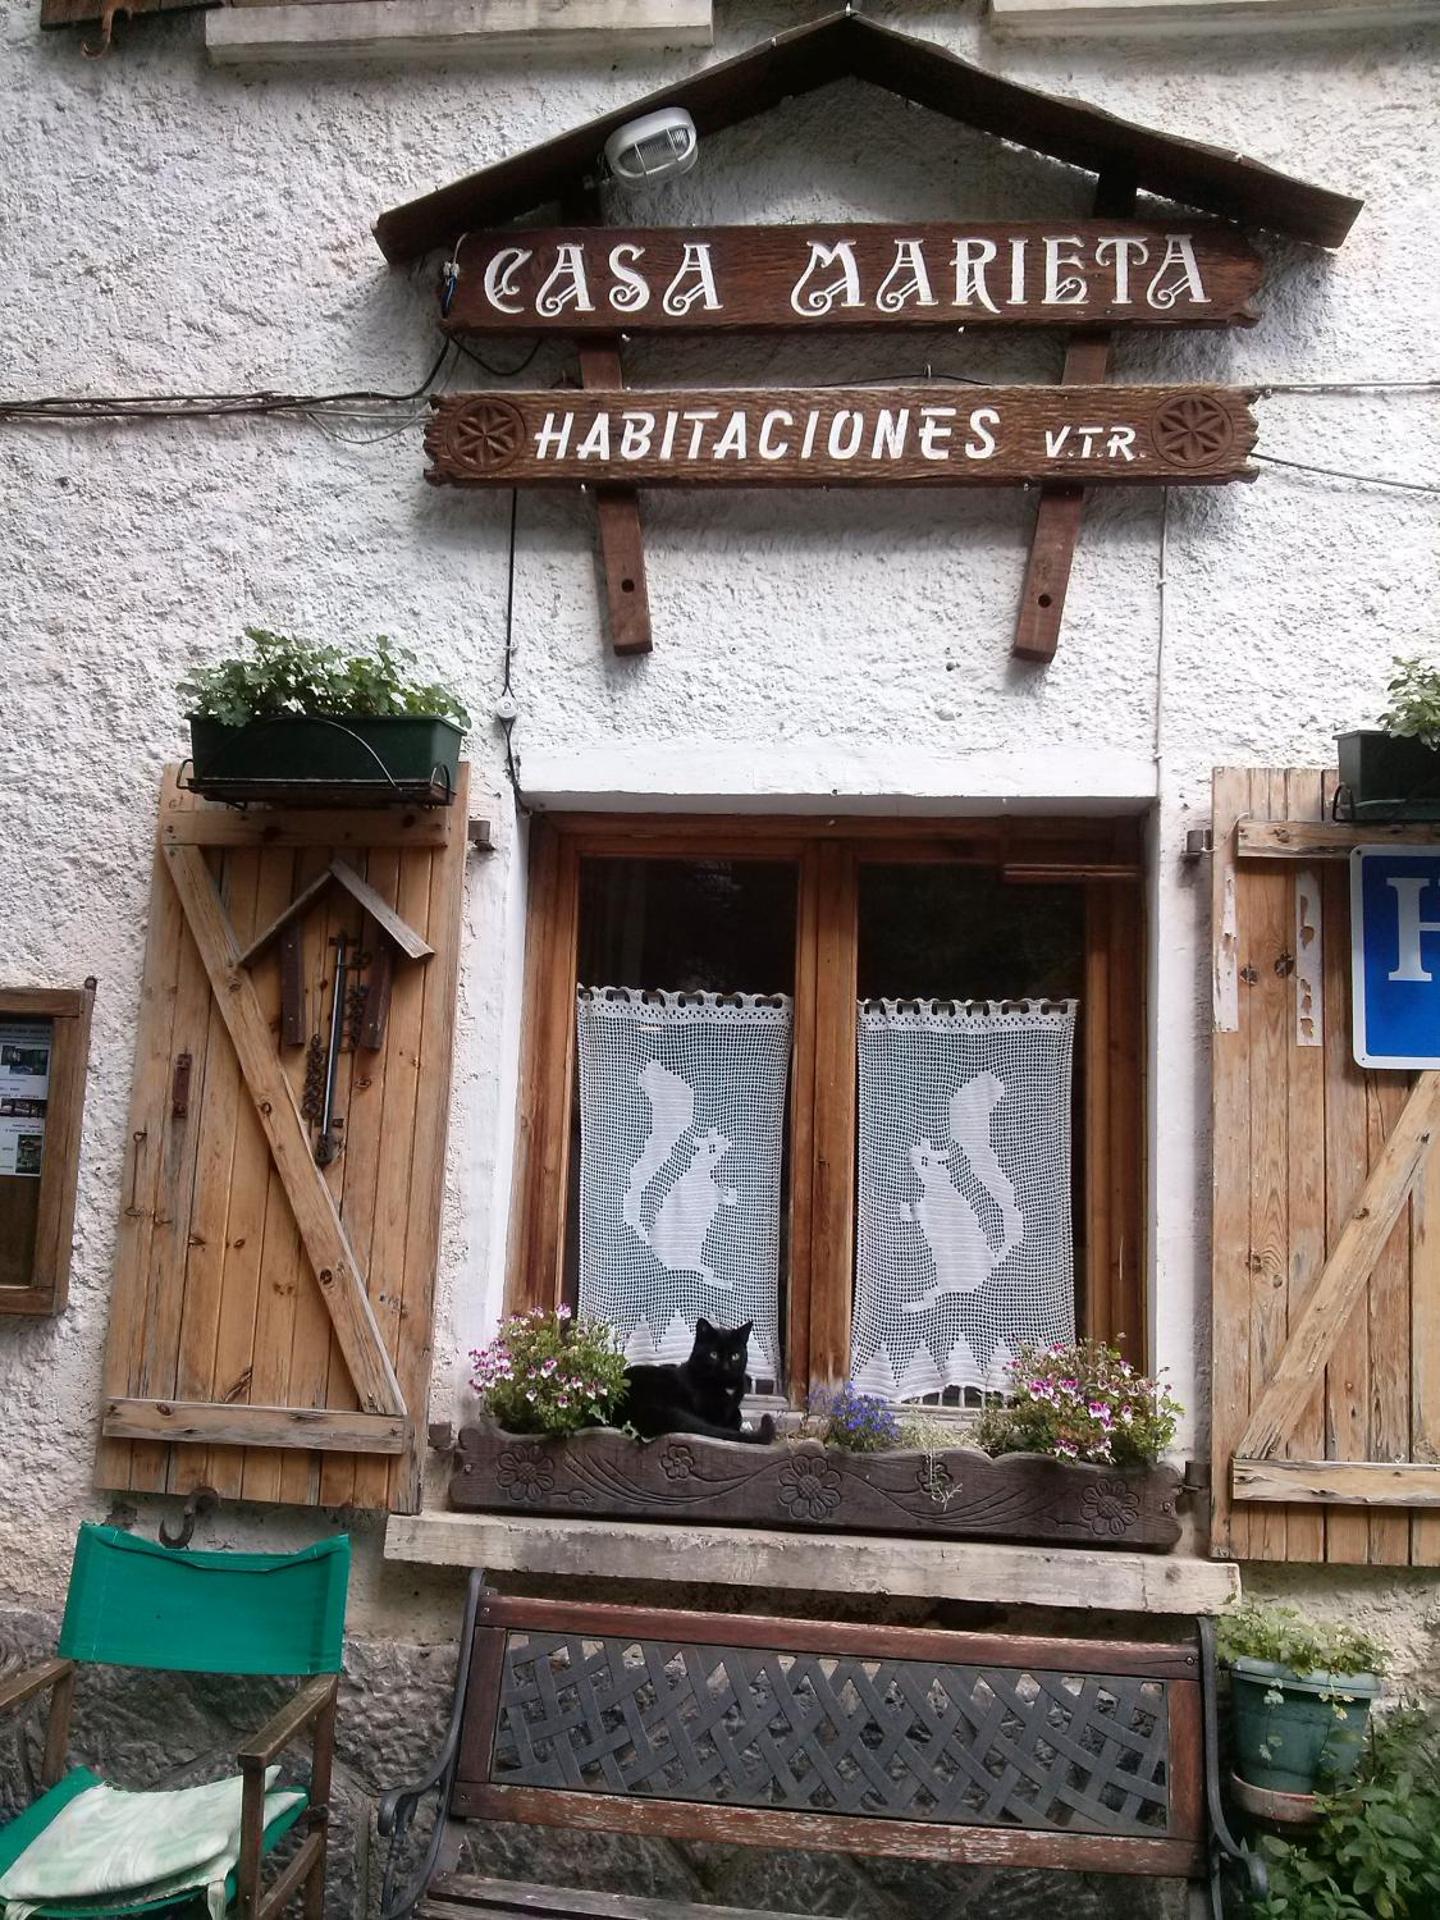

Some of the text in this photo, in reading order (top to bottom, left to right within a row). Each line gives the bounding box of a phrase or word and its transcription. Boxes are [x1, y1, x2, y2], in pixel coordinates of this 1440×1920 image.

[484, 236, 1212, 317] CASA MARIETA
[533, 406, 1001, 461] HABITACIONES
